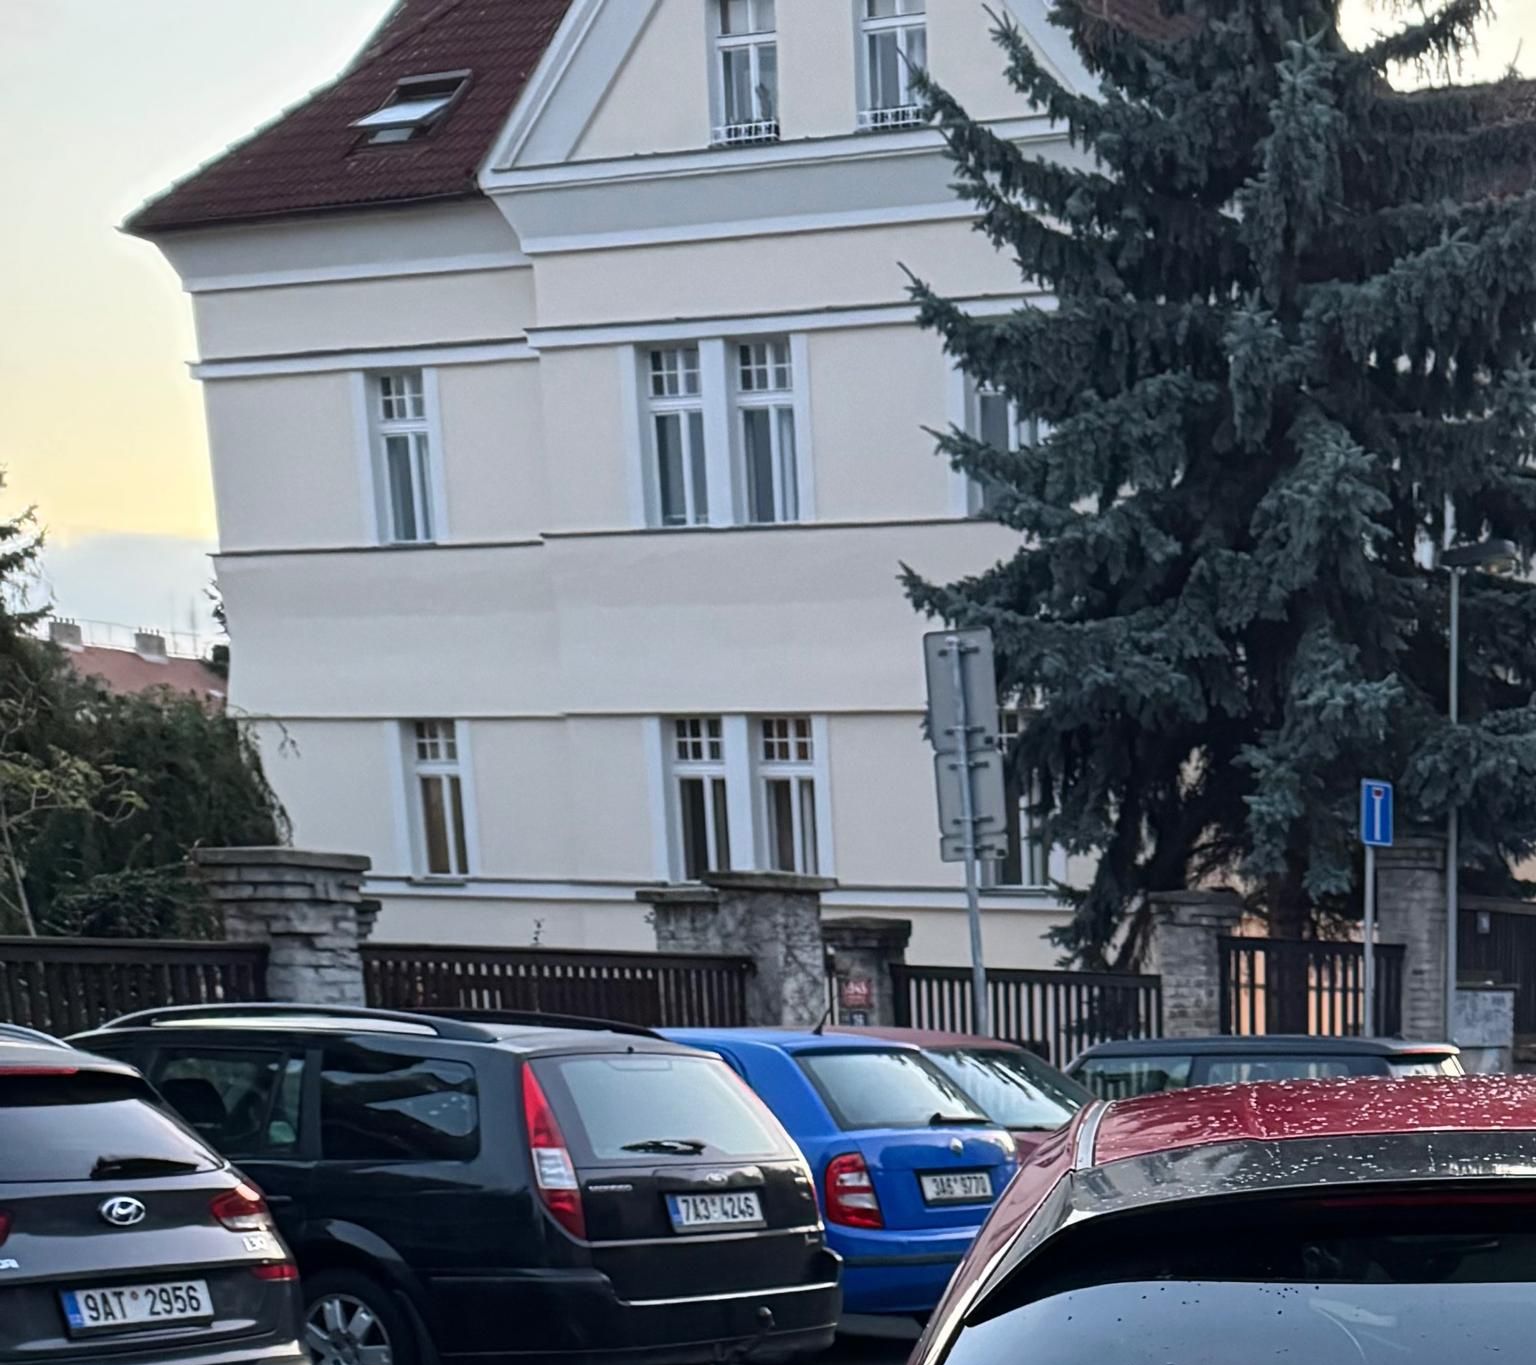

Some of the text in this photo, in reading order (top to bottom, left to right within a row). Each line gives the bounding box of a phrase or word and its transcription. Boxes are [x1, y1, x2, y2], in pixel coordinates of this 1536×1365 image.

[681, 1196, 755, 1222] 7A3 4246
[84, 1285, 200, 1321] 9AT 2956
